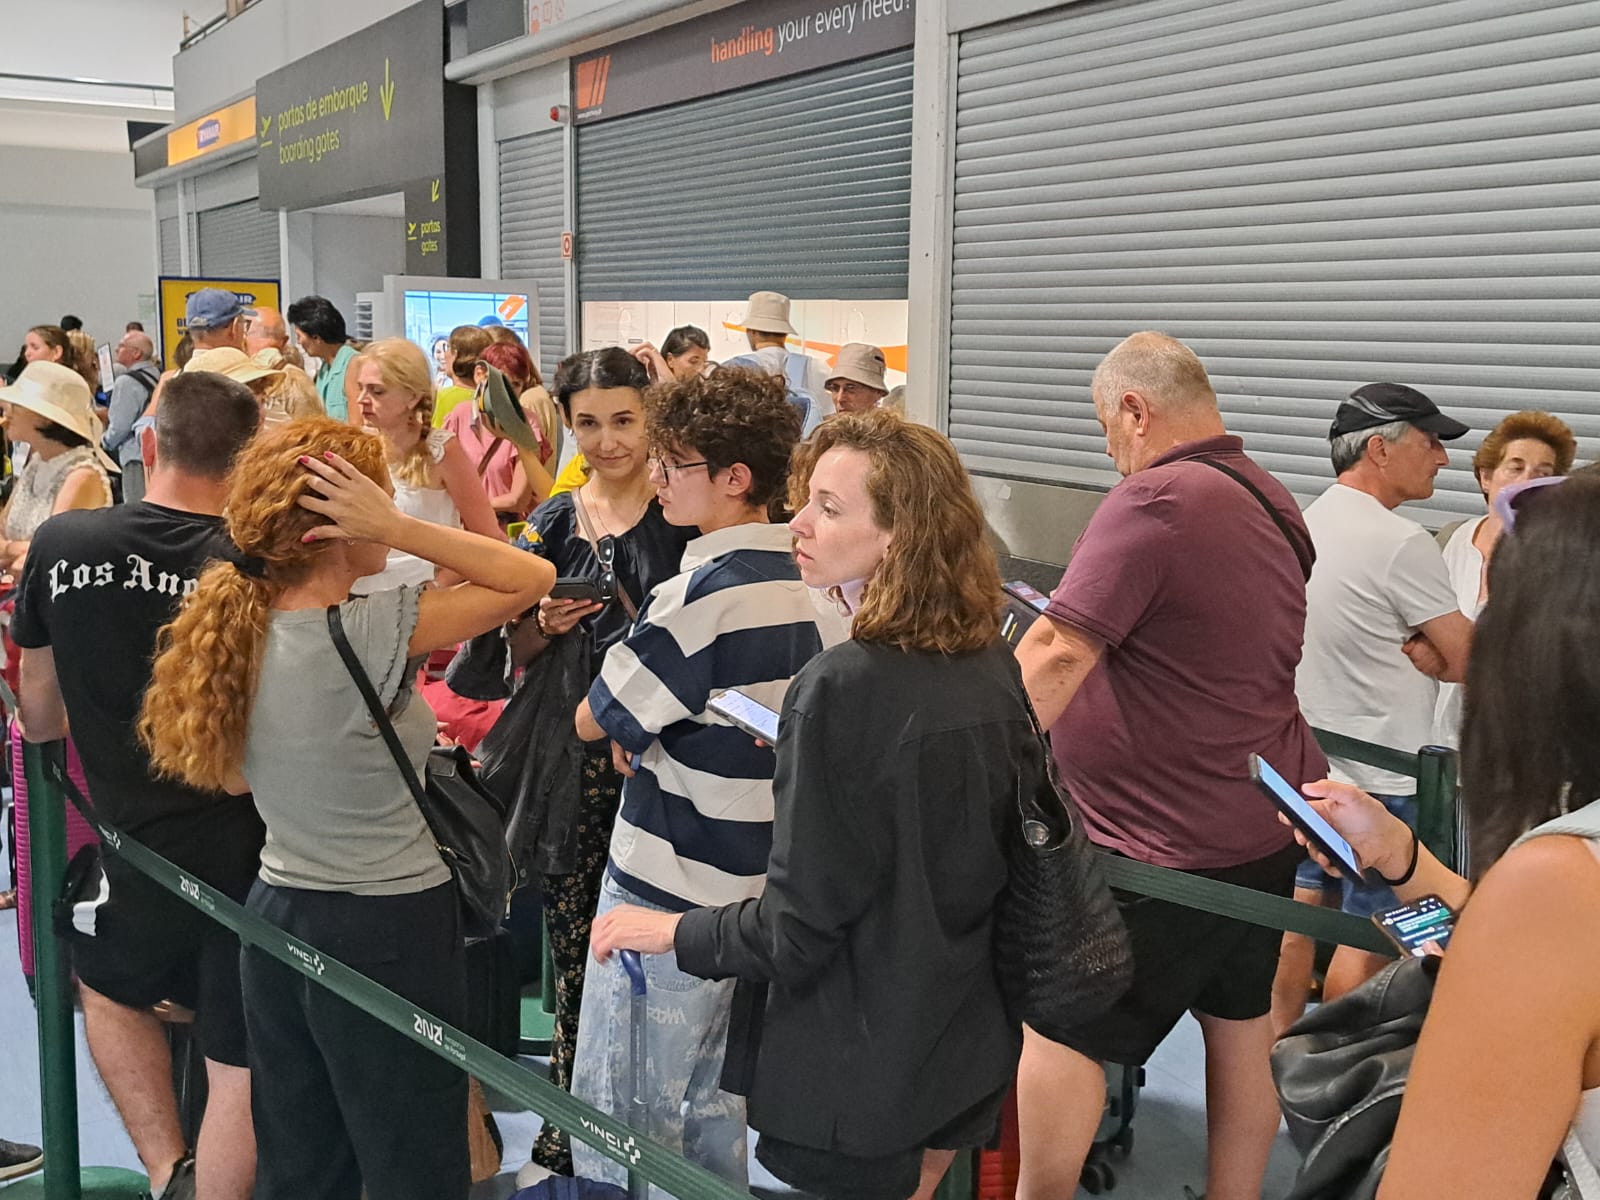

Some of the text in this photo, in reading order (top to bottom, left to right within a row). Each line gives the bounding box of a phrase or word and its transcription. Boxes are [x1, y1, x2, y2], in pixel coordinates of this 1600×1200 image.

[711, 0, 909, 63] handling your every nee
[278, 80, 368, 136] portas de embarque
[280, 127, 340, 164] boarding gates
[48, 559, 115, 603] Los
[286, 941, 313, 965] VINCI
[580, 1116, 621, 1149] VINCI
